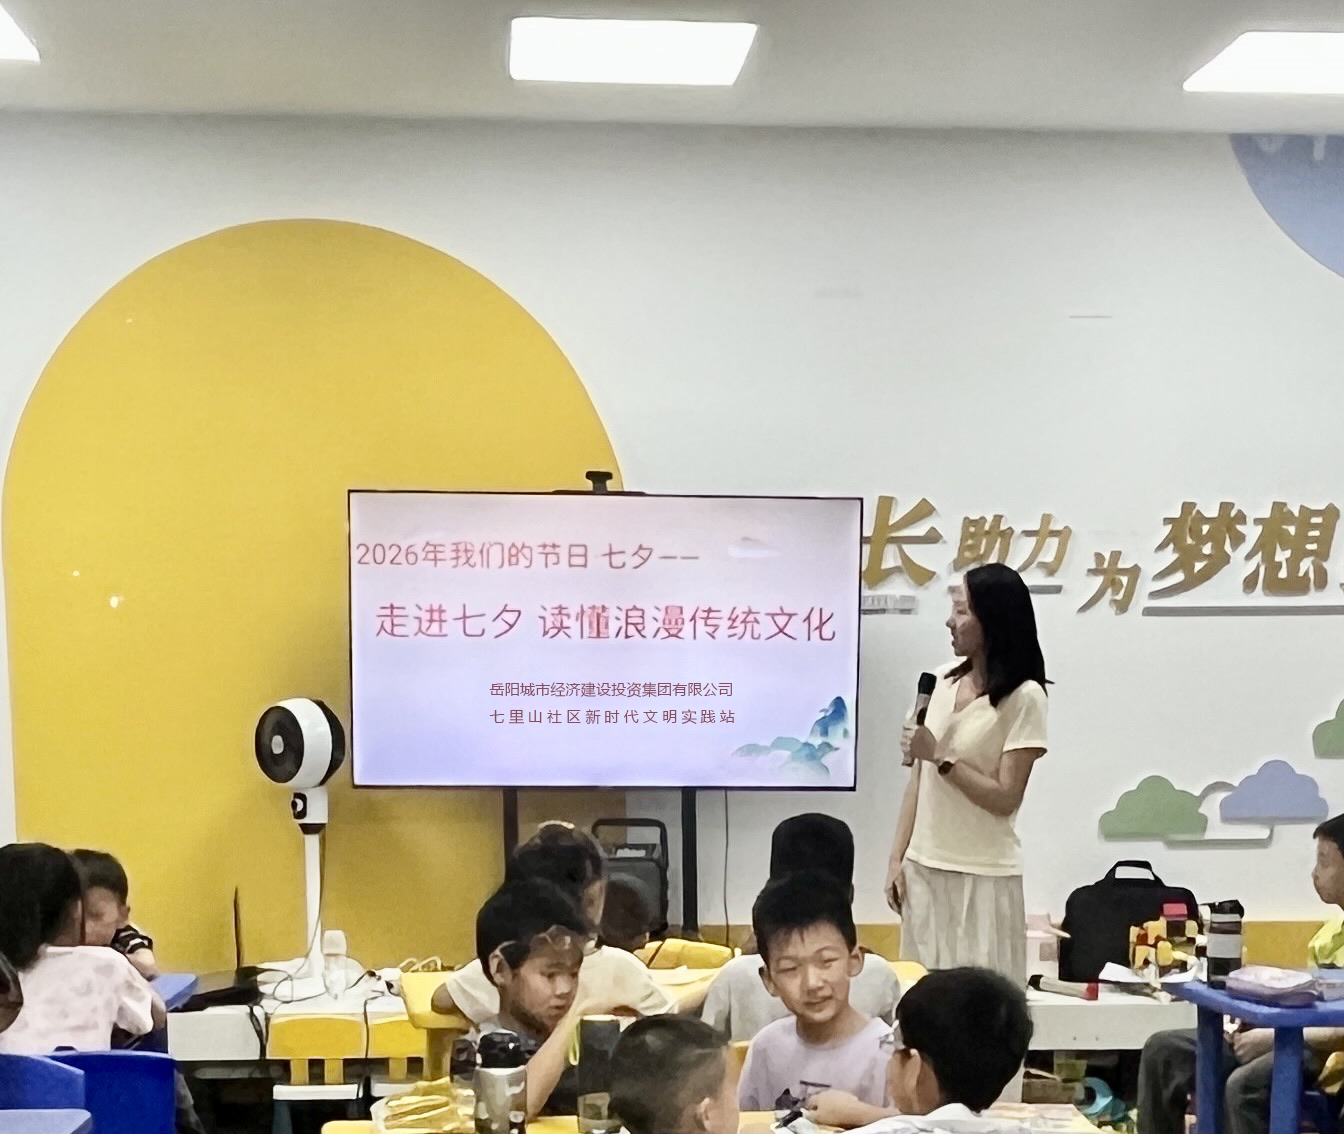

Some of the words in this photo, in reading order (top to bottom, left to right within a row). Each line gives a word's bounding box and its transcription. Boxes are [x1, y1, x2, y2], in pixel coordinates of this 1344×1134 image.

[356, 540, 588, 569] 2026年我们的节日
[375, 603, 522, 639] 走进七夕
[538, 604, 837, 642] 读懂浪漫传统文化
[489, 682, 734, 698] 岳阳城市经济建设投资集团有限公司
[489, 709, 736, 725] 七里山社区新时代文明实践站
